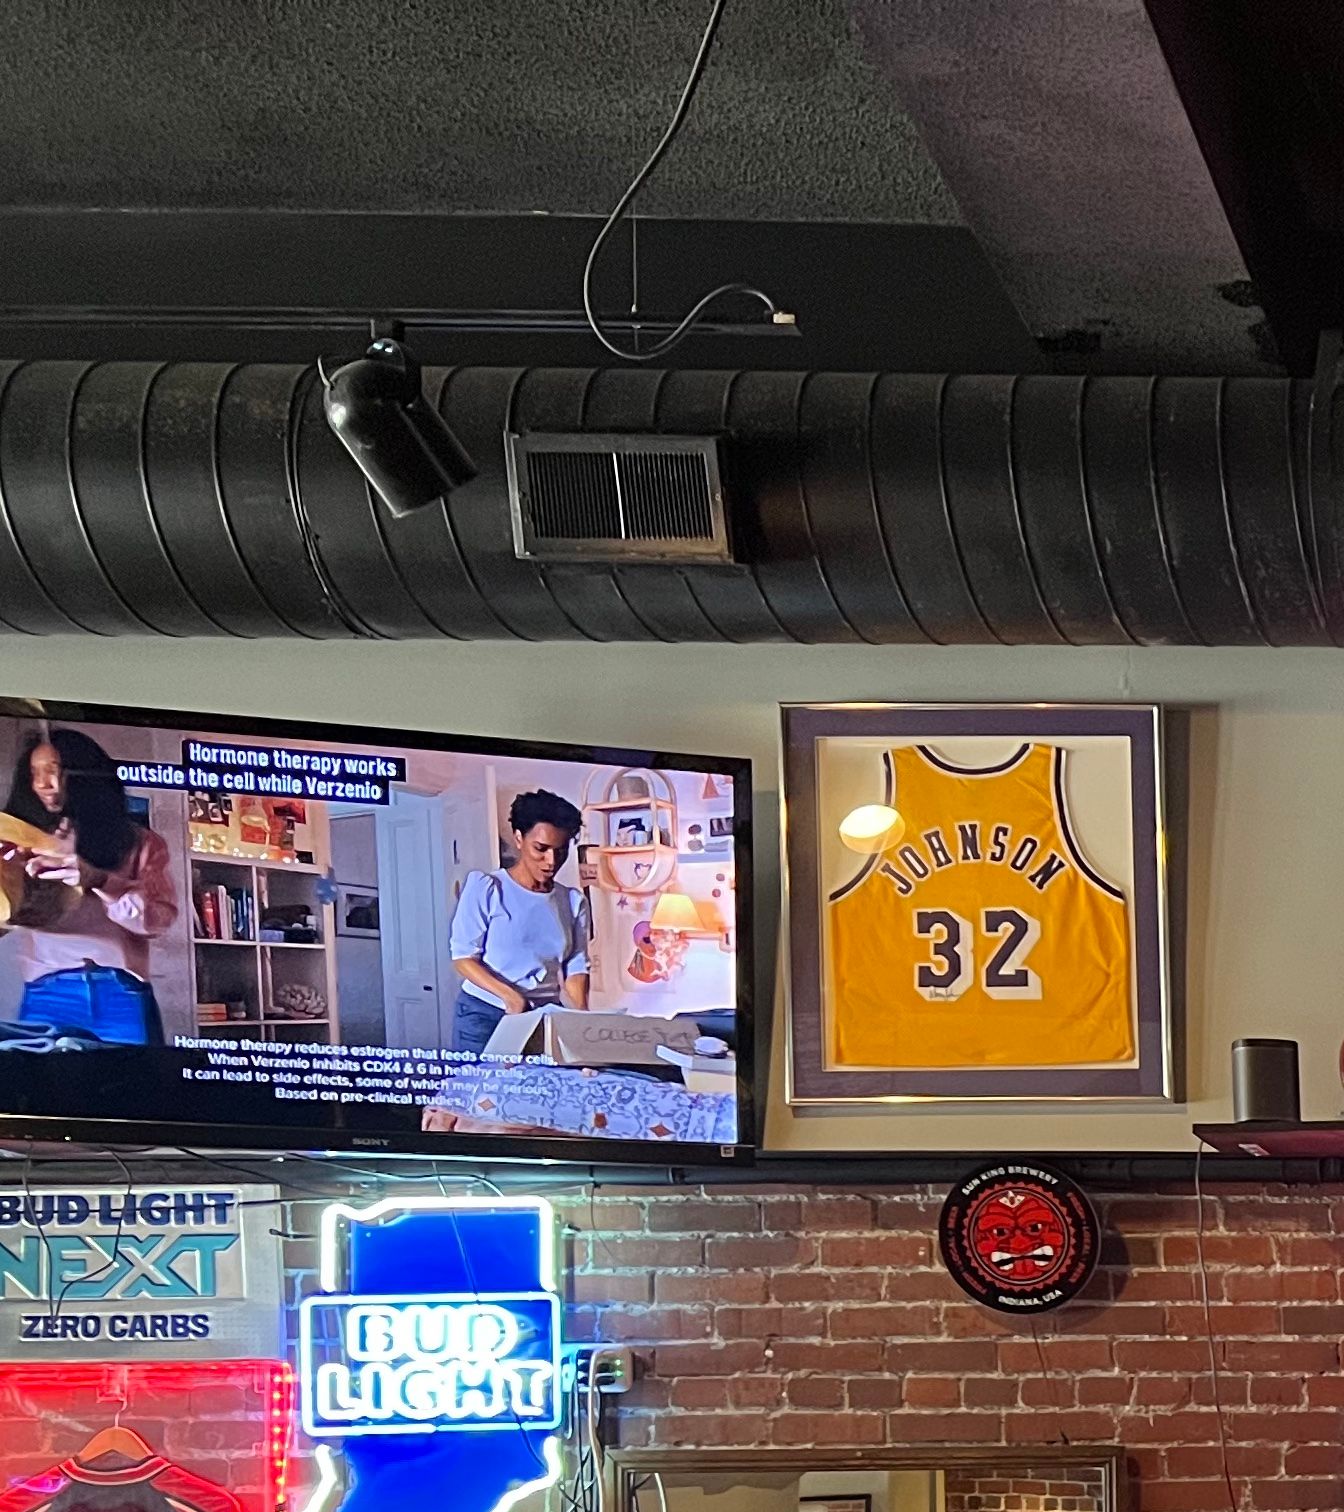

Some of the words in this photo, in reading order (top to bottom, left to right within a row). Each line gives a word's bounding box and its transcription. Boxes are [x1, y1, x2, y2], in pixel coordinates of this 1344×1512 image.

[189, 742, 268, 767] Hormone
[273, 749, 339, 776] therapy
[344, 758, 397, 777] works
[116, 764, 184, 785] outside
[189, 768, 219, 787] the
[223, 772, 255, 791] cell
[258, 775, 302, 794] while
[305, 777, 382, 800] Verzenio
[878, 823, 1071, 897] JOHNSON
[912, 907, 1042, 1001] 32
[174, 1036, 238, 1050] Hormone
[241, 1039, 292, 1055] therapy
[295, 1043, 348, 1056] reduces
[351, 1046, 409, 1060] estrogen
[413, 1048, 437, 1060] that
[441, 1049, 477, 1062] feeds
[480, 1053, 523, 1064] cancer
[526, 1054, 558, 1066] cells.
[208, 1053, 249, 1066] When
[251, 1055, 310, 1069] Verzenio
[313, 1059, 361, 1072] inhibits
[363, 1061, 400, 1074] CDK4
[404, 1062, 414, 1074] &
[417, 1062, 426, 1075] 6
[430, 1063, 442, 1075] in
[445, 1064, 492, 1079] healthy
[183, 1068, 193, 1079] It
[195, 1070, 220, 1081] can
[223, 1069, 253, 1082] lead
[255, 1071, 270, 1083] to
[272, 1072, 301, 1084] side
[303, 1073, 353, 1088] effects,
[355, 1077, 392, 1088] some
[395, 1077, 409, 1089] of
[411, 1078, 449, 1091] which
[452, 1081, 479, 1094] may
[482, 1081, 499, 1092] be
[274, 1087, 318, 1100] Based
[320, 1090, 338, 1101] on
[340, 1091, 412, 1105] pre-clinical
[352, 1137, 391, 1147] SONY
[1008, 1165, 1059, 1185] BREWERY
[0, 1194, 90, 1226] BUD
[100, 1193, 234, 1226] LIGHT
[0, 1234, 240, 1298] NEXT
[22, 1314, 100, 1339] ZERO
[108, 1314, 210, 1339] CARBS
[346, 1304, 517, 1362] BUD
[317, 1360, 553, 1419] LIGHT
